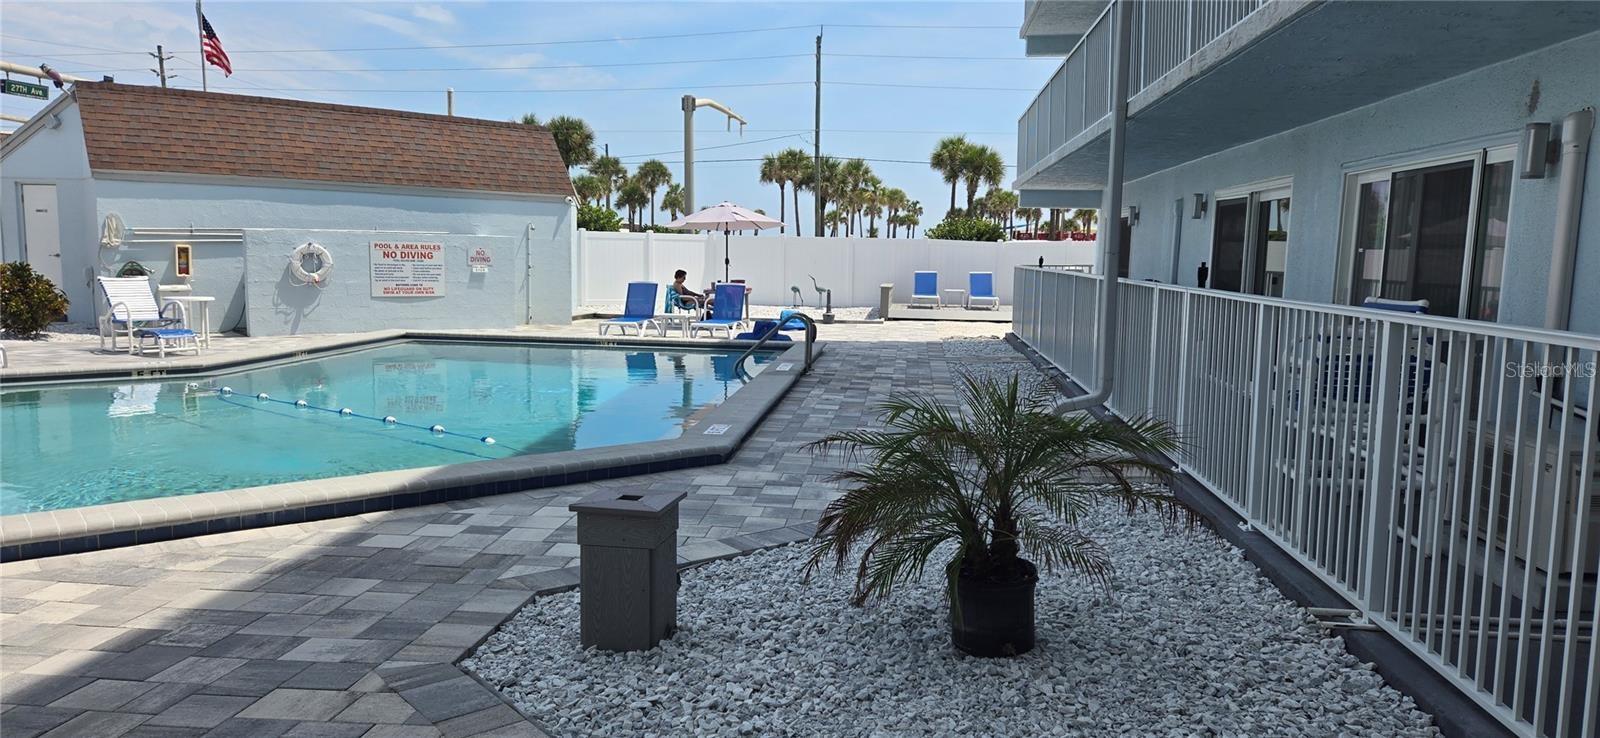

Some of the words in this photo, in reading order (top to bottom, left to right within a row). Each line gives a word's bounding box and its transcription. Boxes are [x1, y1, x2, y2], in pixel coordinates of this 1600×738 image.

[11, 84, 28, 94] 27TH
[383, 251, 397, 259] NO
[400, 251, 434, 260] DIVING
